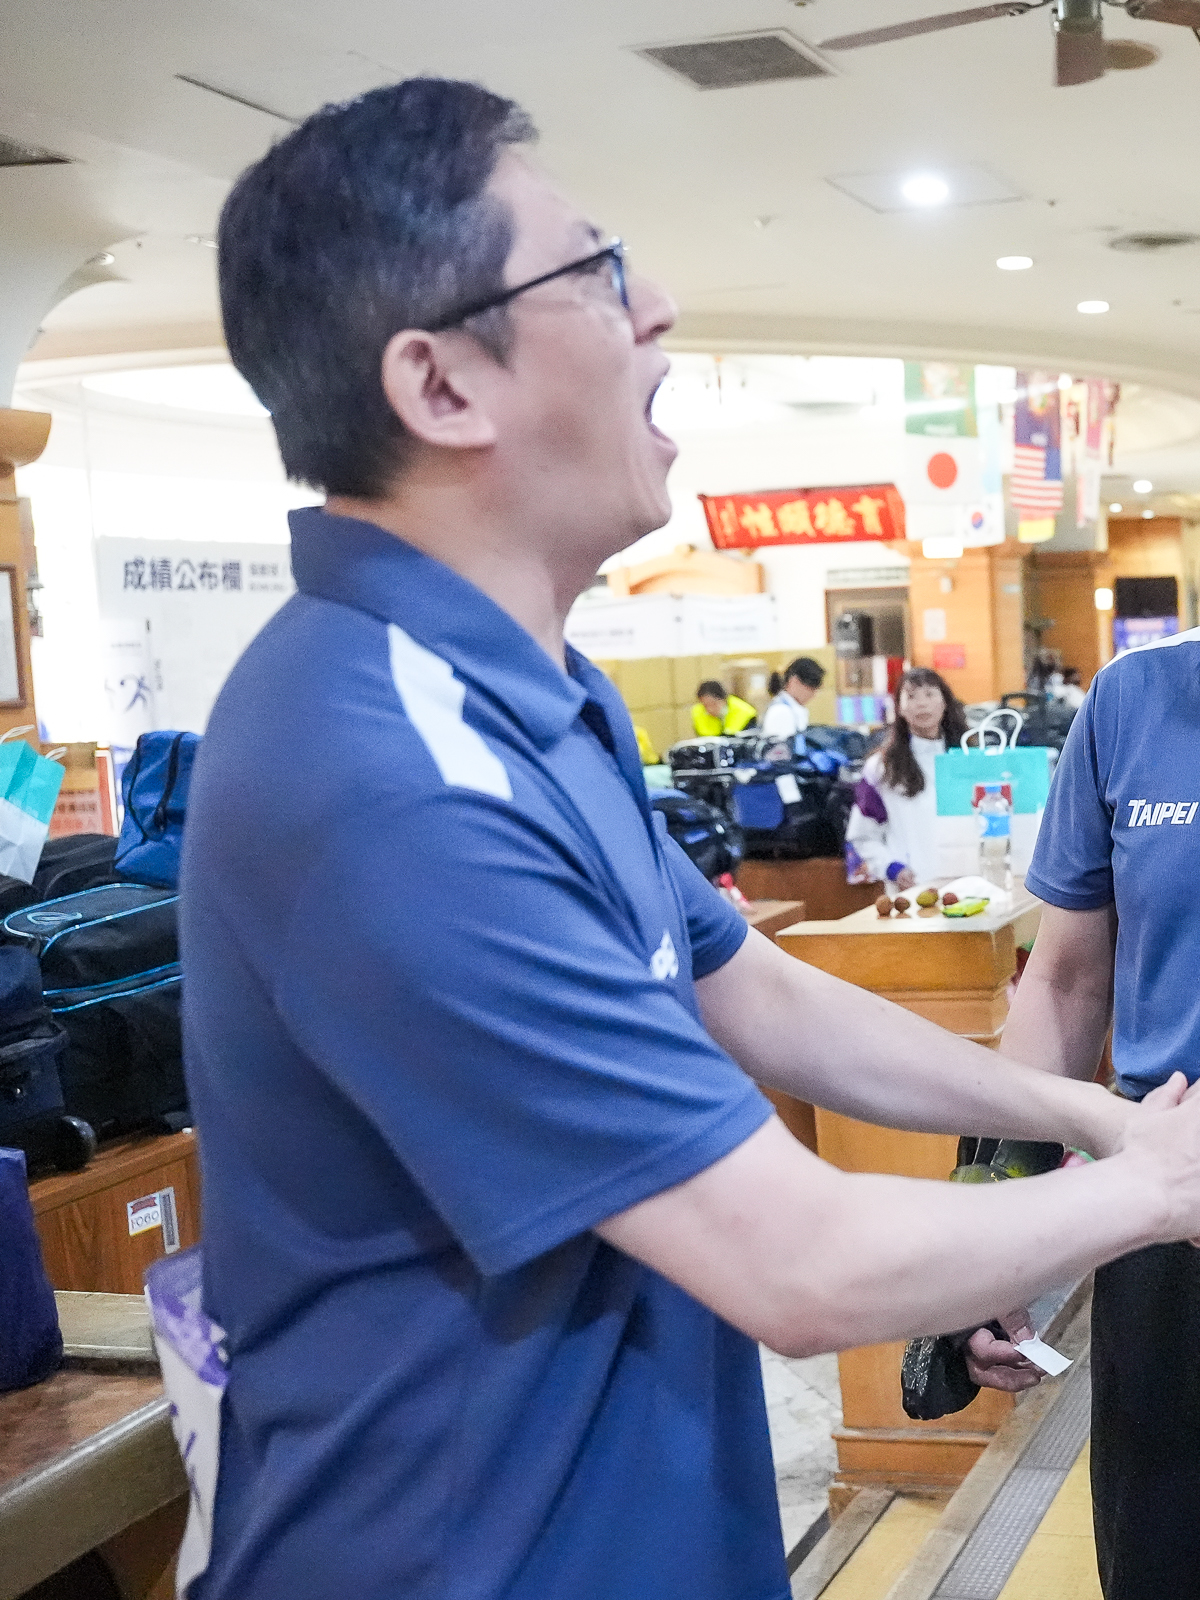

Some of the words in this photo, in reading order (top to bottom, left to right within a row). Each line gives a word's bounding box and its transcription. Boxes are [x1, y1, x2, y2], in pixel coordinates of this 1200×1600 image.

[123, 556, 241, 590] 成績公布欄
[1127, 799, 1199, 827] TAIPEI
